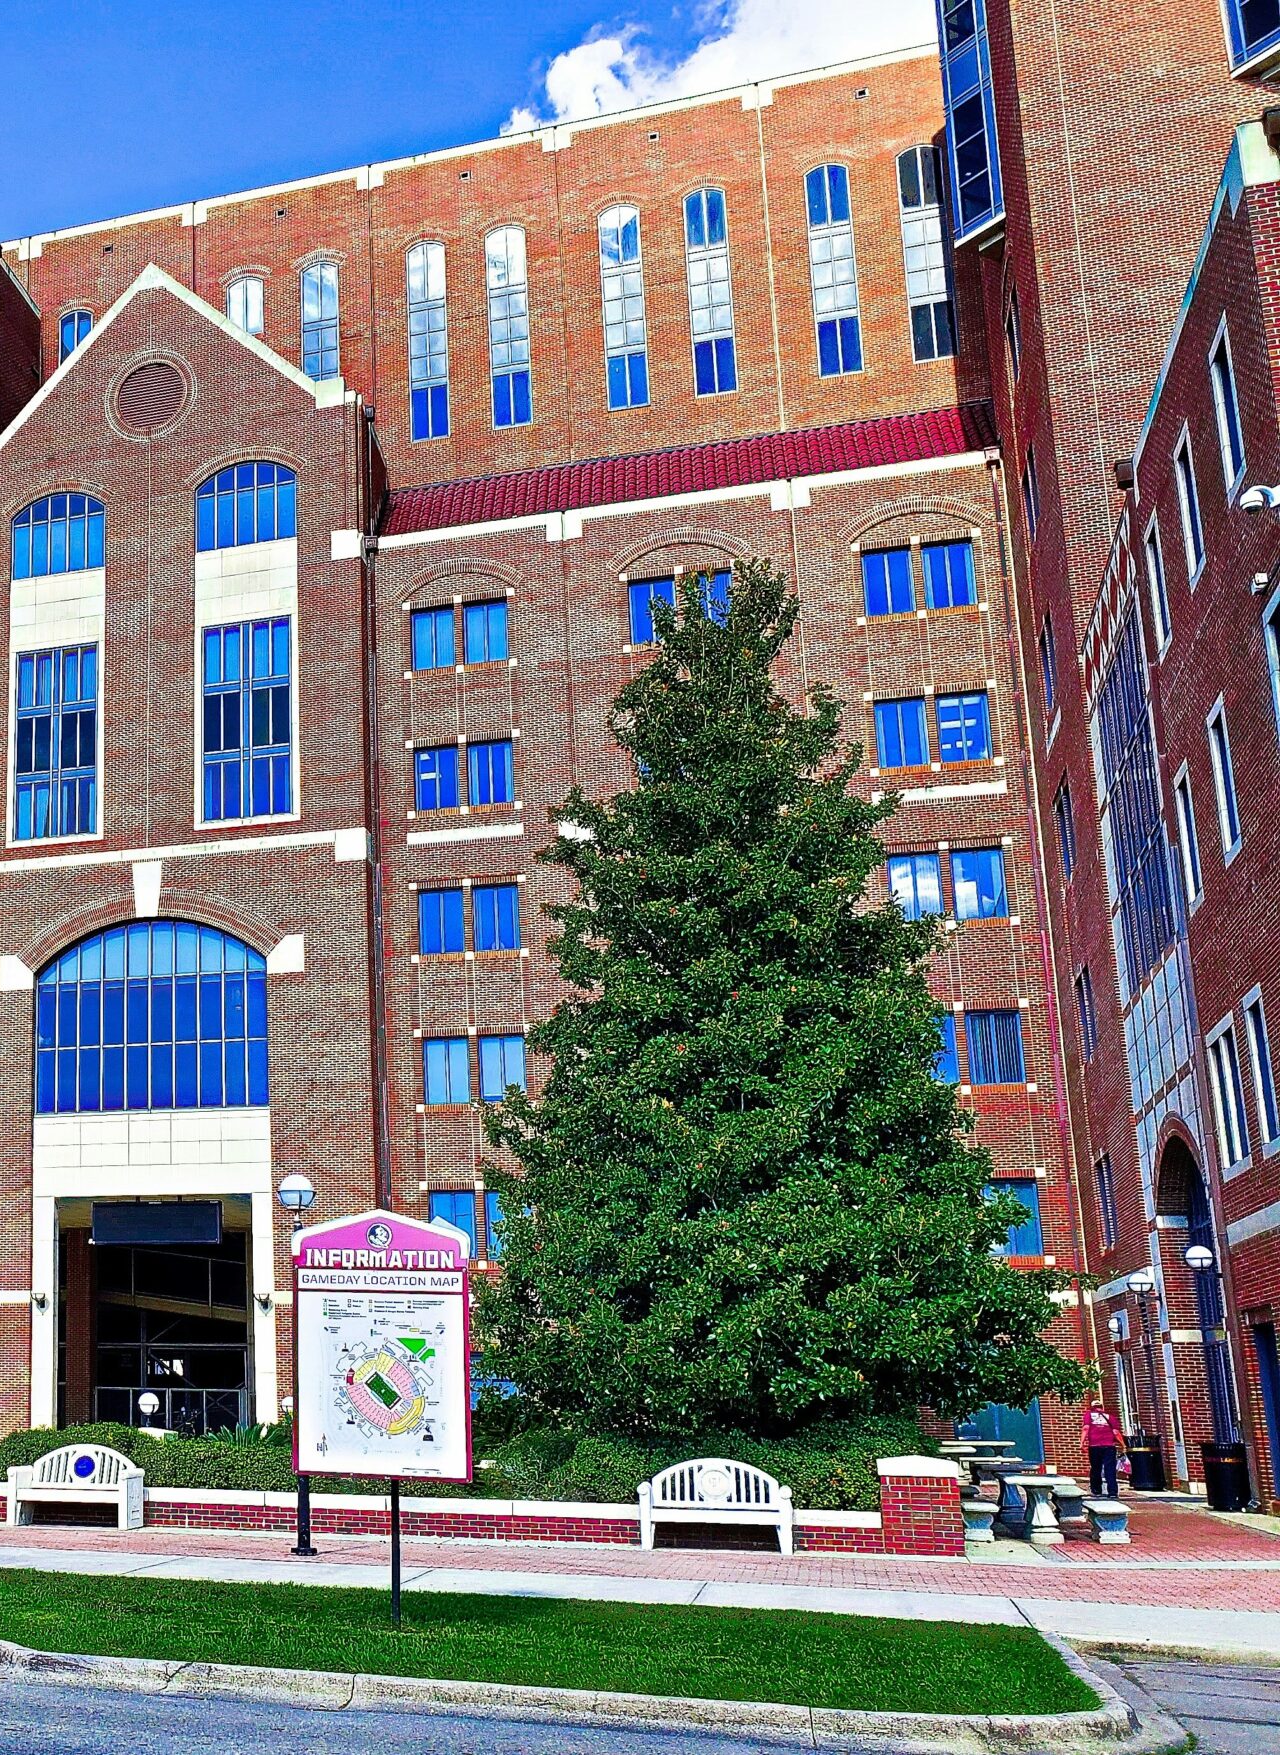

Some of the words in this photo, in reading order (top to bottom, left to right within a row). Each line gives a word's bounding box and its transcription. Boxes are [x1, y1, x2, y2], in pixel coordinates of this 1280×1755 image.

[305, 1248, 455, 1270] INFORMATION
[302, 1274, 361, 1285] GAMEDAY
[364, 1276, 426, 1286] LOCATION
[430, 1277, 459, 1287] MAP
